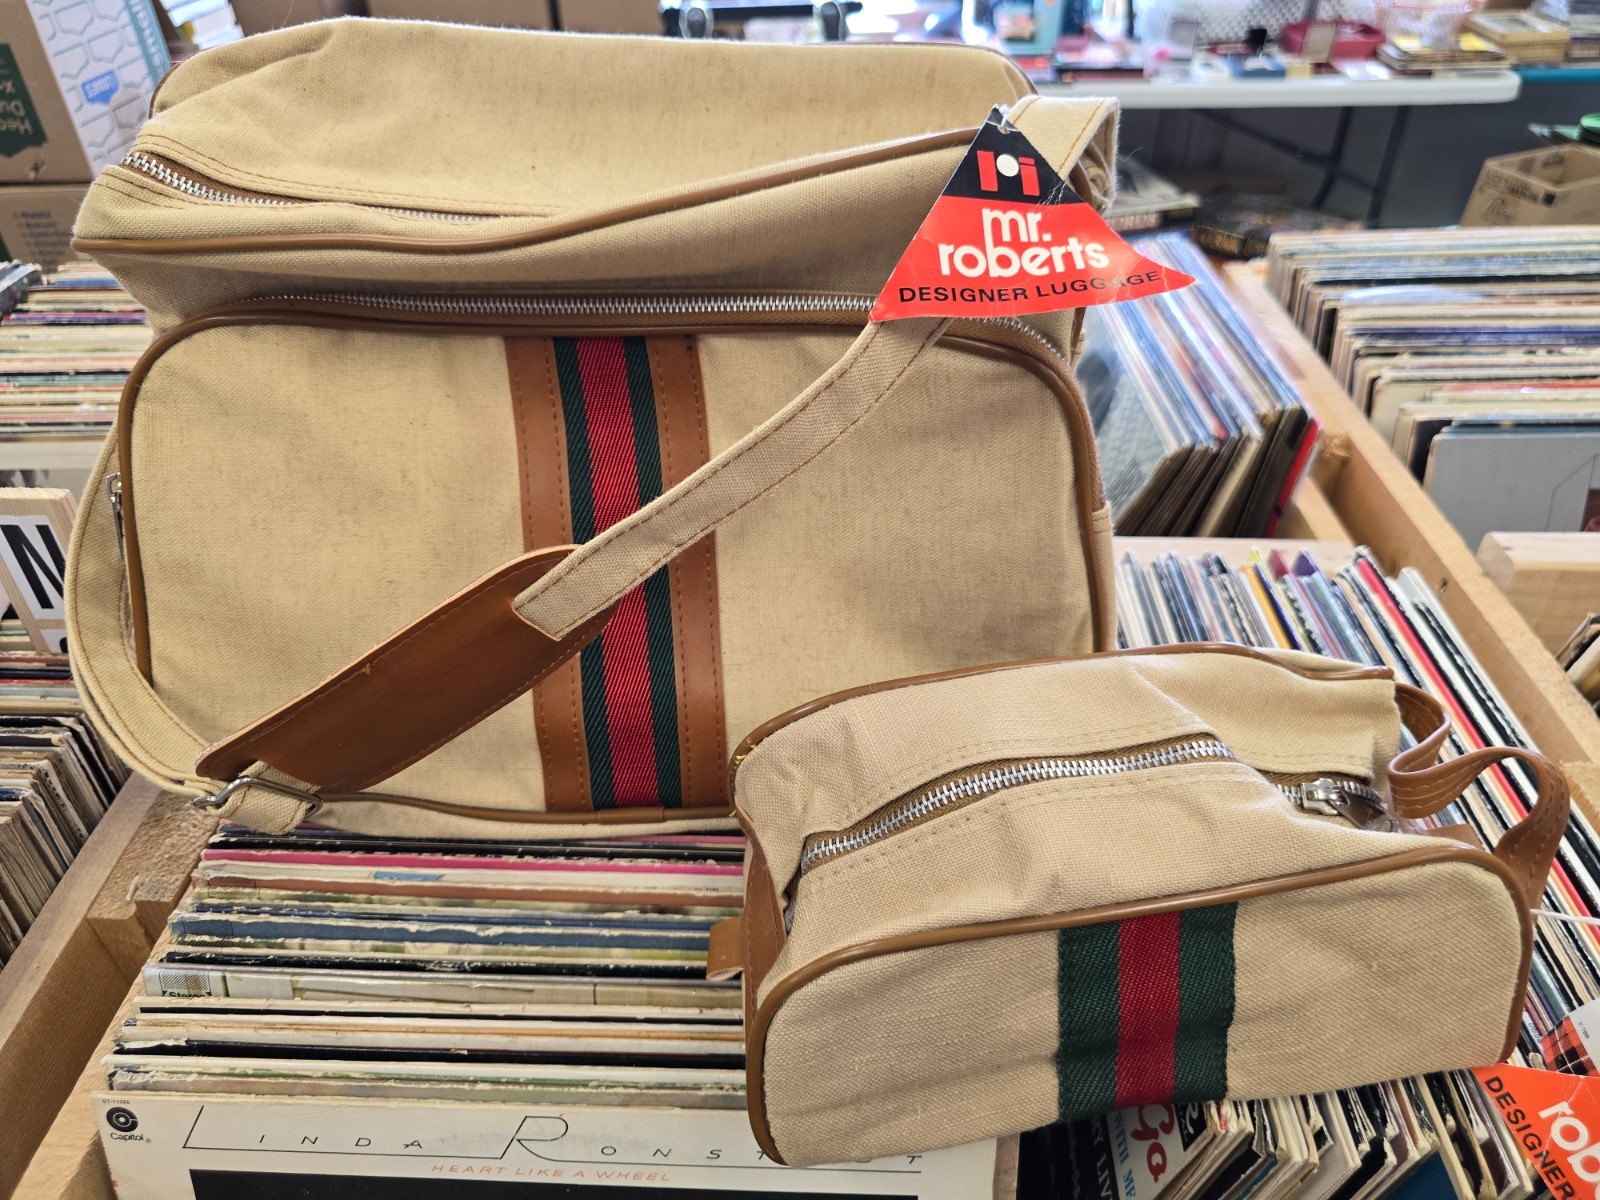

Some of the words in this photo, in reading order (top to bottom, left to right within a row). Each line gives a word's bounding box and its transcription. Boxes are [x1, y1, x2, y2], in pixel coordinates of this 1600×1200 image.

[981, 207, 1051, 243] mr.
[937, 236, 1110, 278] roberts
[899, 286, 1029, 303] DESIGNER
[1035, 270, 1162, 298] LUGGAGE
[0, 524, 66, 609] N
[110, 1132, 145, 1142] Capitol
[183, 1105, 424, 1152] LINDA
[500, 1115, 924, 1172] RONSTT
[1484, 1075, 1575, 1200] DESIGNER
[1537, 1100, 1600, 1200] rob
[431, 1163, 508, 1175] HEART
[514, 1166, 563, 1178] LIKE
[571, 1167, 586, 1178] A
[596, 1169, 671, 1182] WHEEL
